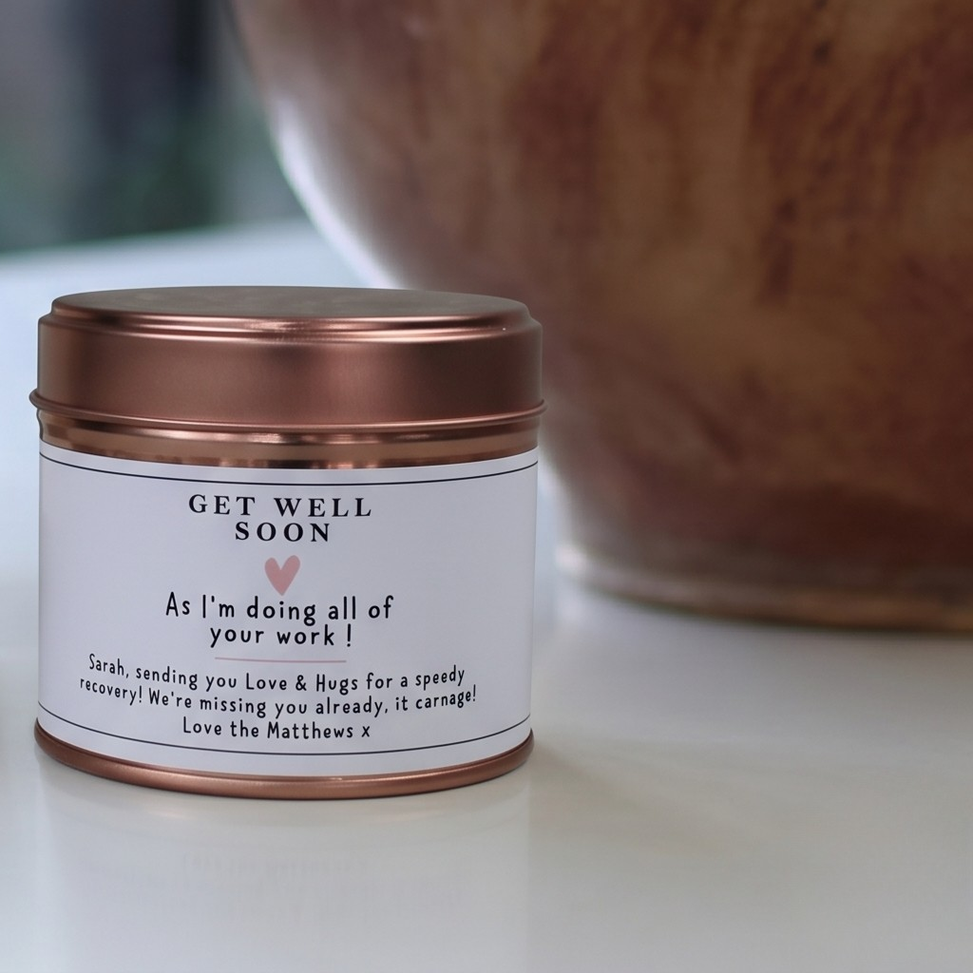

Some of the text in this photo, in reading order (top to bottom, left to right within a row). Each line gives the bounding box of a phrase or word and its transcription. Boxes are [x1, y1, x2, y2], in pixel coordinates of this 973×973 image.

[189, 494, 371, 517] GET WELL
[235, 521, 329, 542] SOON
[166, 591, 394, 626] As I'm doing all of
[210, 627, 264, 648] your
[89, 653, 465, 695] Sarah, sending you Love & Hugs for a speedy
[80, 678, 477, 719] recovery! We're missing you already, it carnage!
[183, 716, 370, 739] Love the Matthews x
